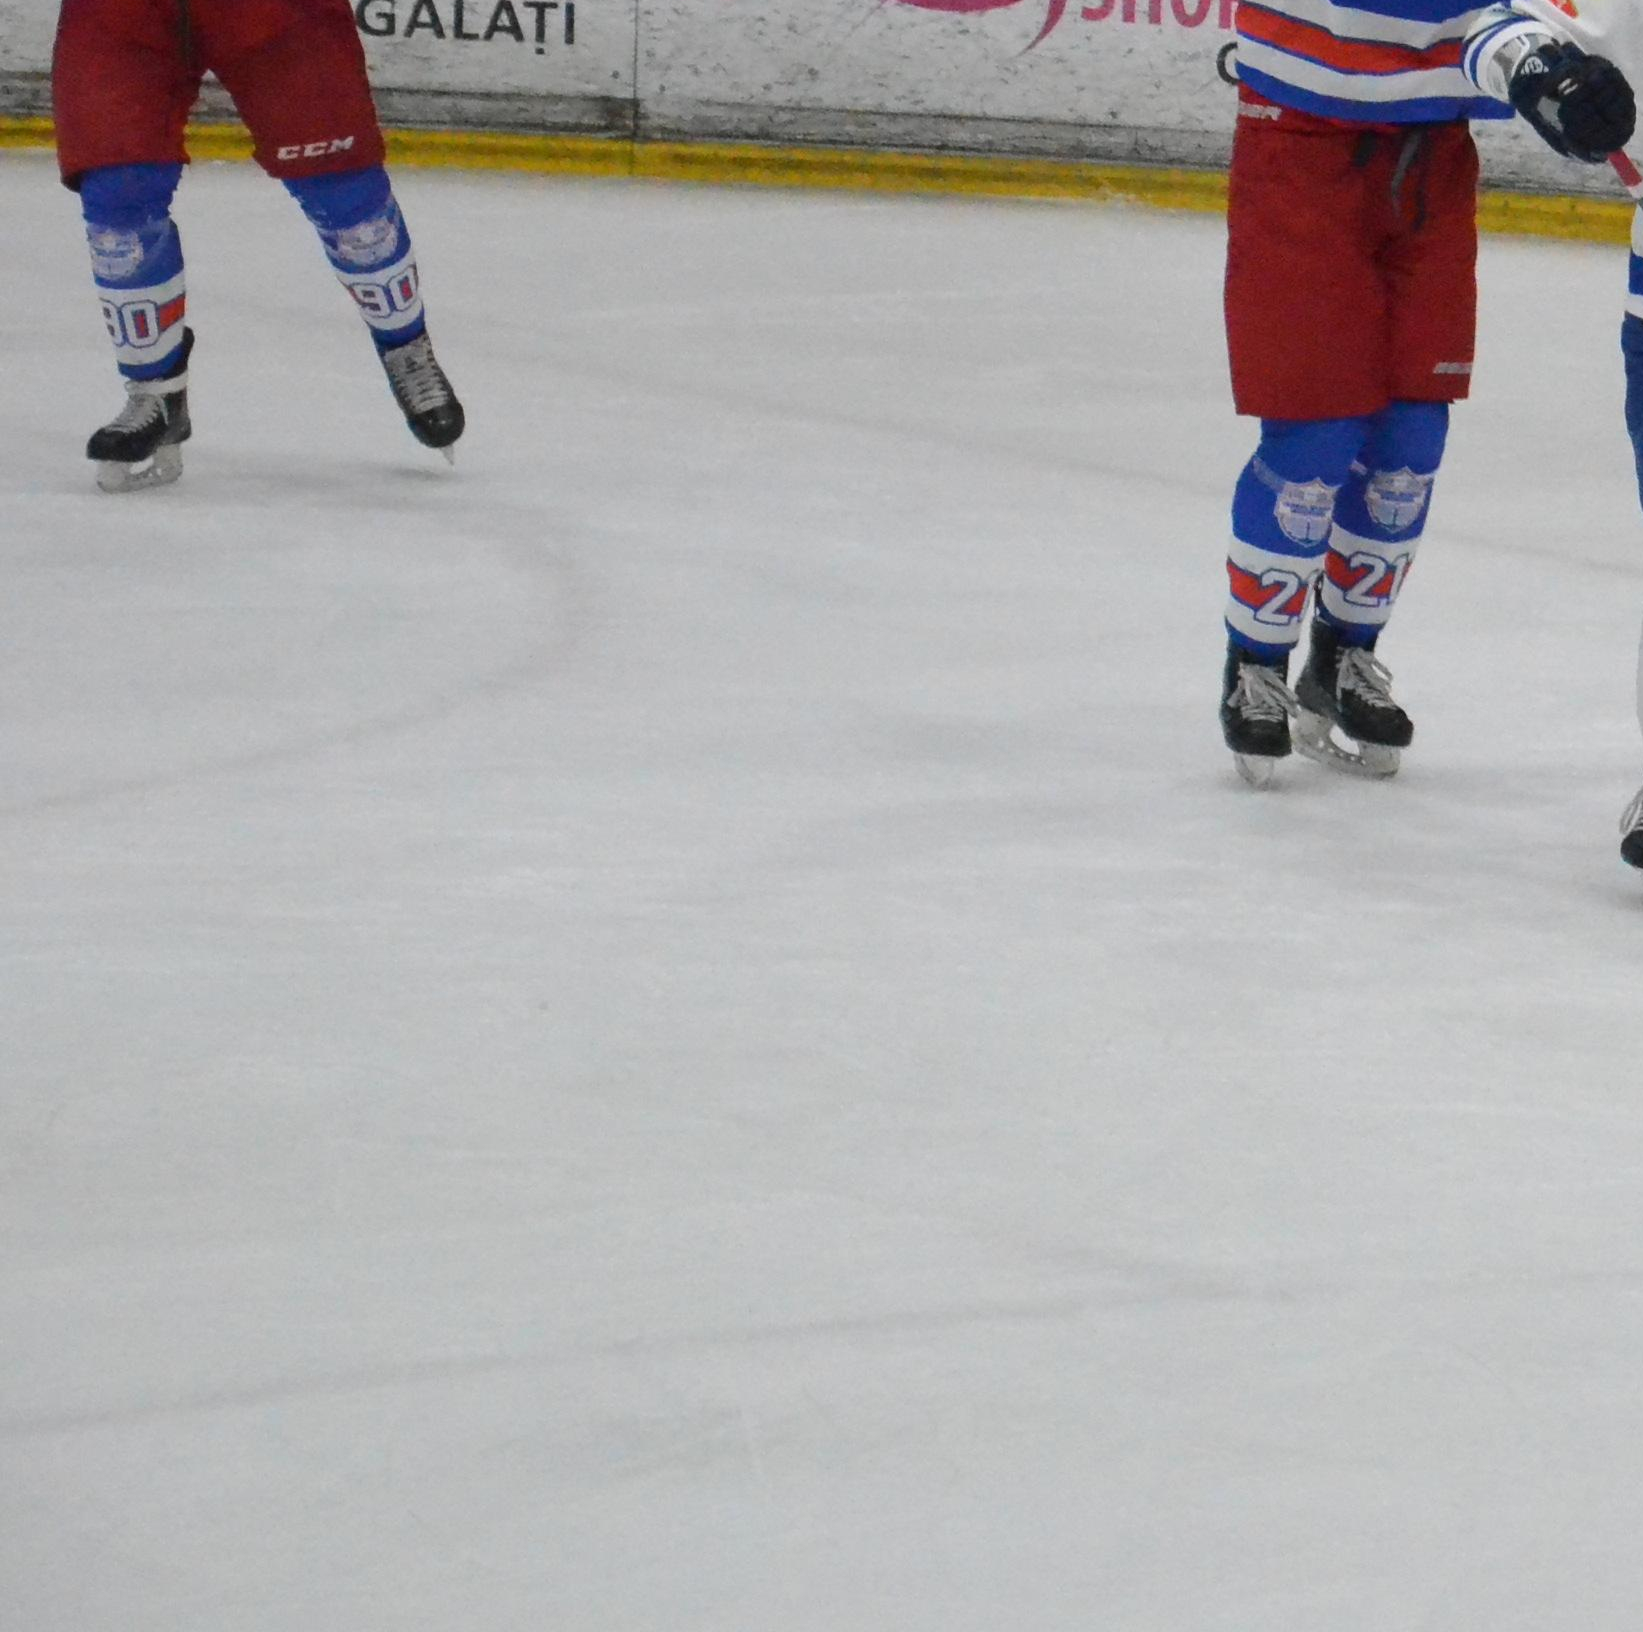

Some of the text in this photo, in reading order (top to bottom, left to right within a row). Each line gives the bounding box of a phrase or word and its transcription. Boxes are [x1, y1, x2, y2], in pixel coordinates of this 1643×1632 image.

[276, 135, 355, 161] CCM
[352, 270, 416, 318] 90
[1253, 567, 1322, 626] 21
[1344, 551, 1411, 608] 21
